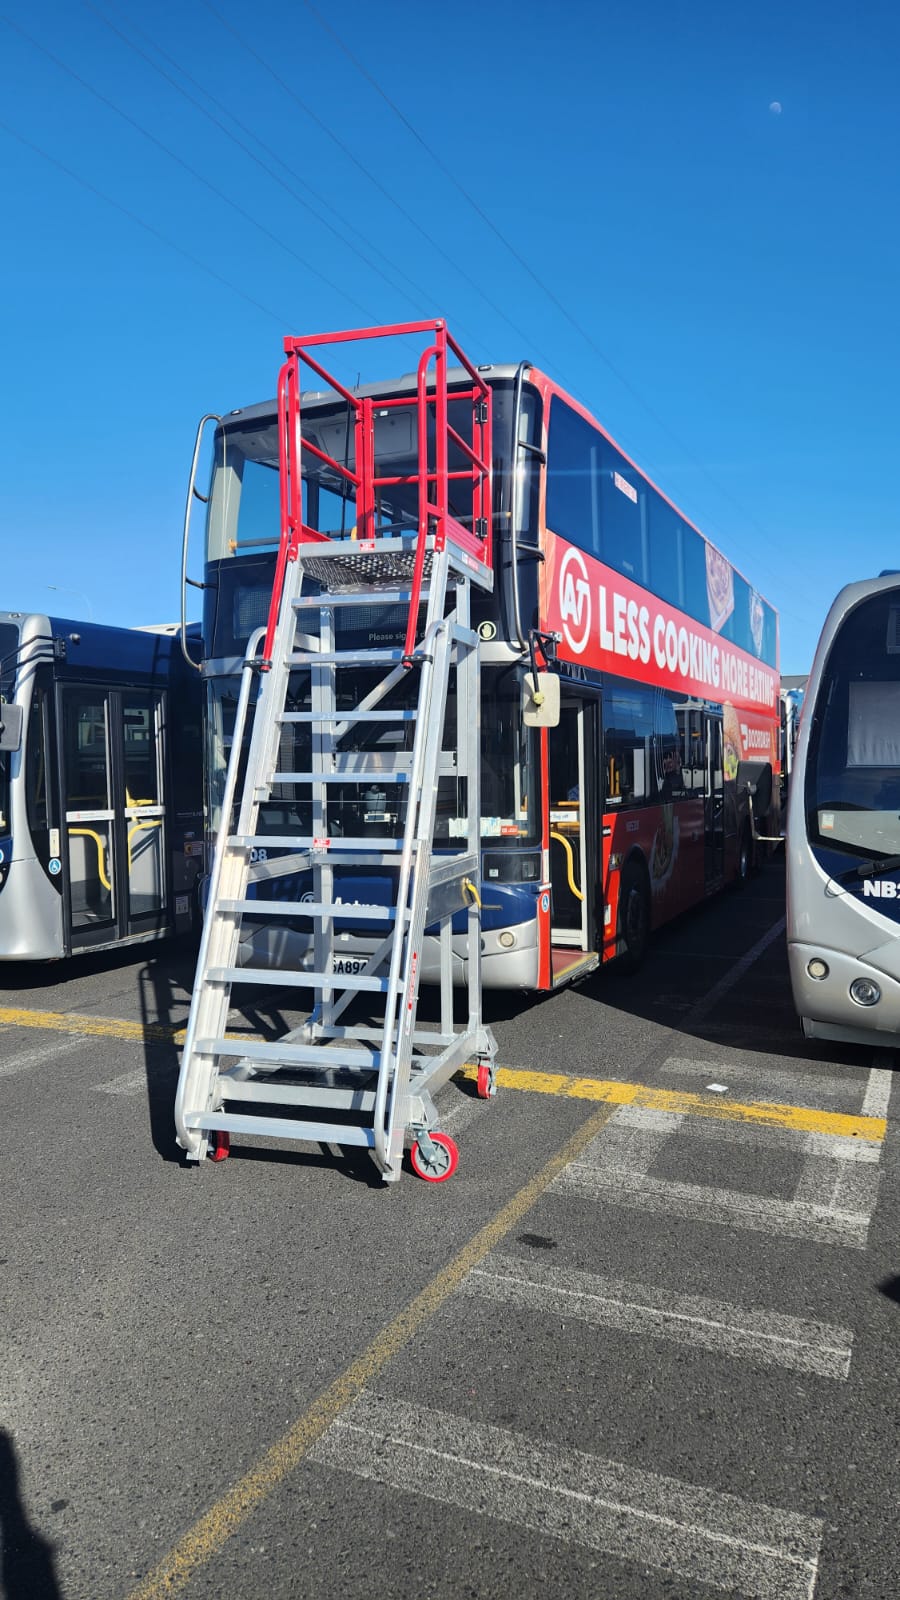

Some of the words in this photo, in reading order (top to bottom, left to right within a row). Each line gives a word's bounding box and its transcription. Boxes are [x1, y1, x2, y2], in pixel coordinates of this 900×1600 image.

[368, 633, 394, 641] Please
[562, 573, 589, 626] AT
[599, 586, 650, 664] LESS
[654, 614, 720, 689] COOKING
[721, 650, 749, 697] MORE
[749, 665, 775, 709] EATING
